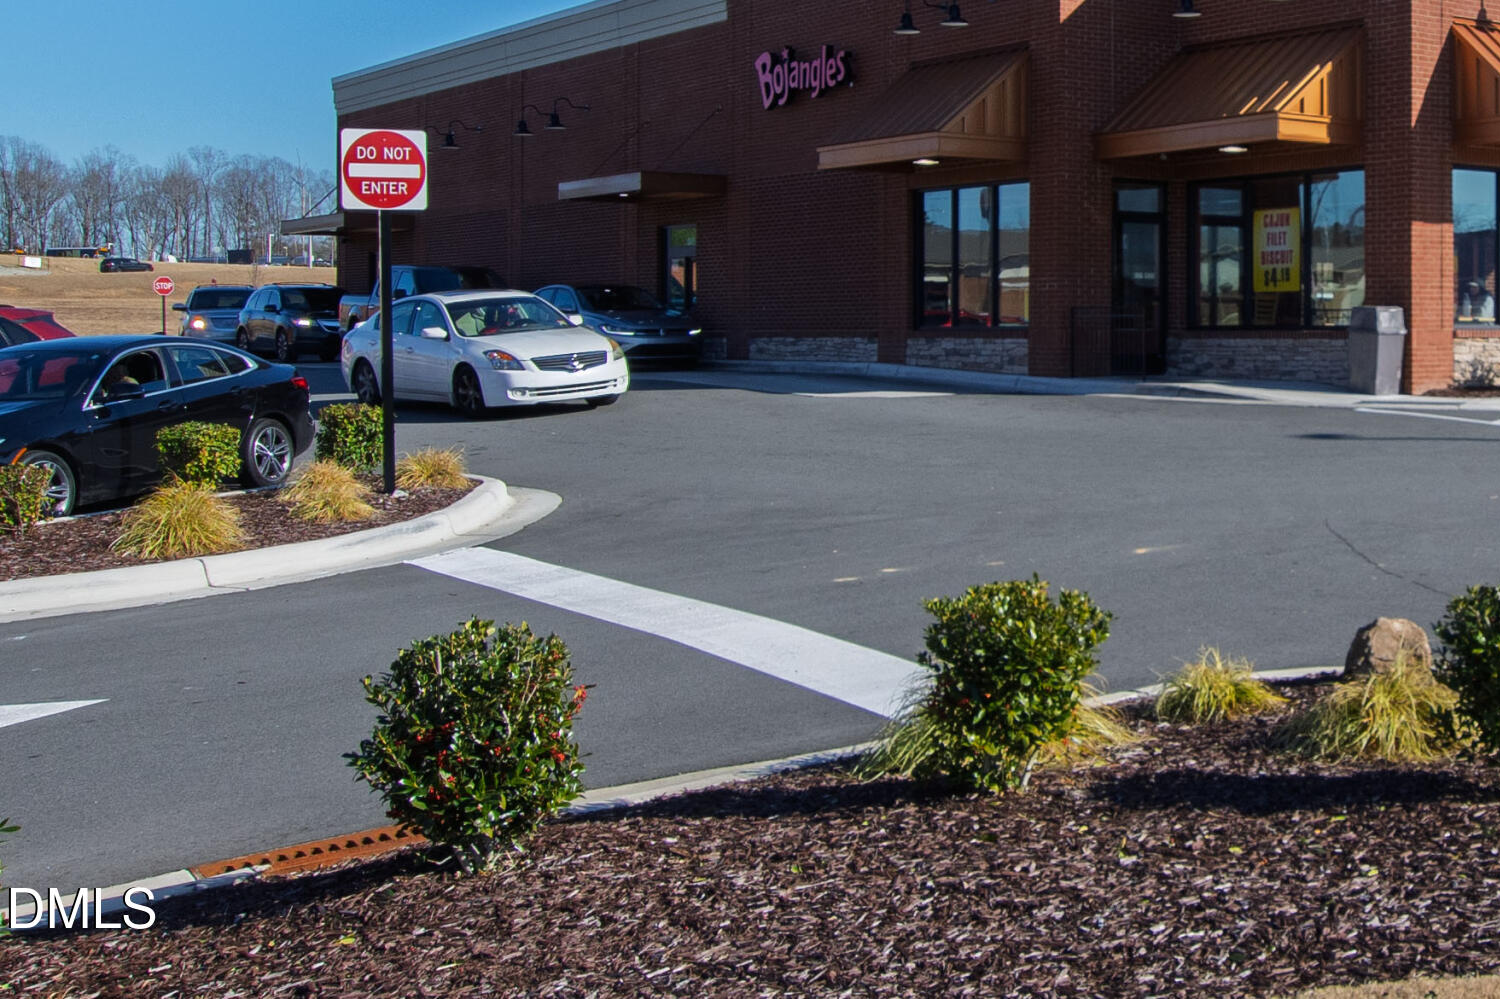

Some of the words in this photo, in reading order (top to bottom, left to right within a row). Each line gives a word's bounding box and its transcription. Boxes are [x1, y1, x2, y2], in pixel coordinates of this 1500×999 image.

[754, 44, 846, 110] Bojangles
[356, 145, 377, 160] DO
[383, 146, 412, 161] NOT
[361, 180, 408, 196] ENTER
[1263, 213, 1291, 228] CAJUN
[1266, 231, 1287, 246] FILET
[1261, 249, 1294, 266] BISCUIT
[155, 281, 174, 290] STOP
